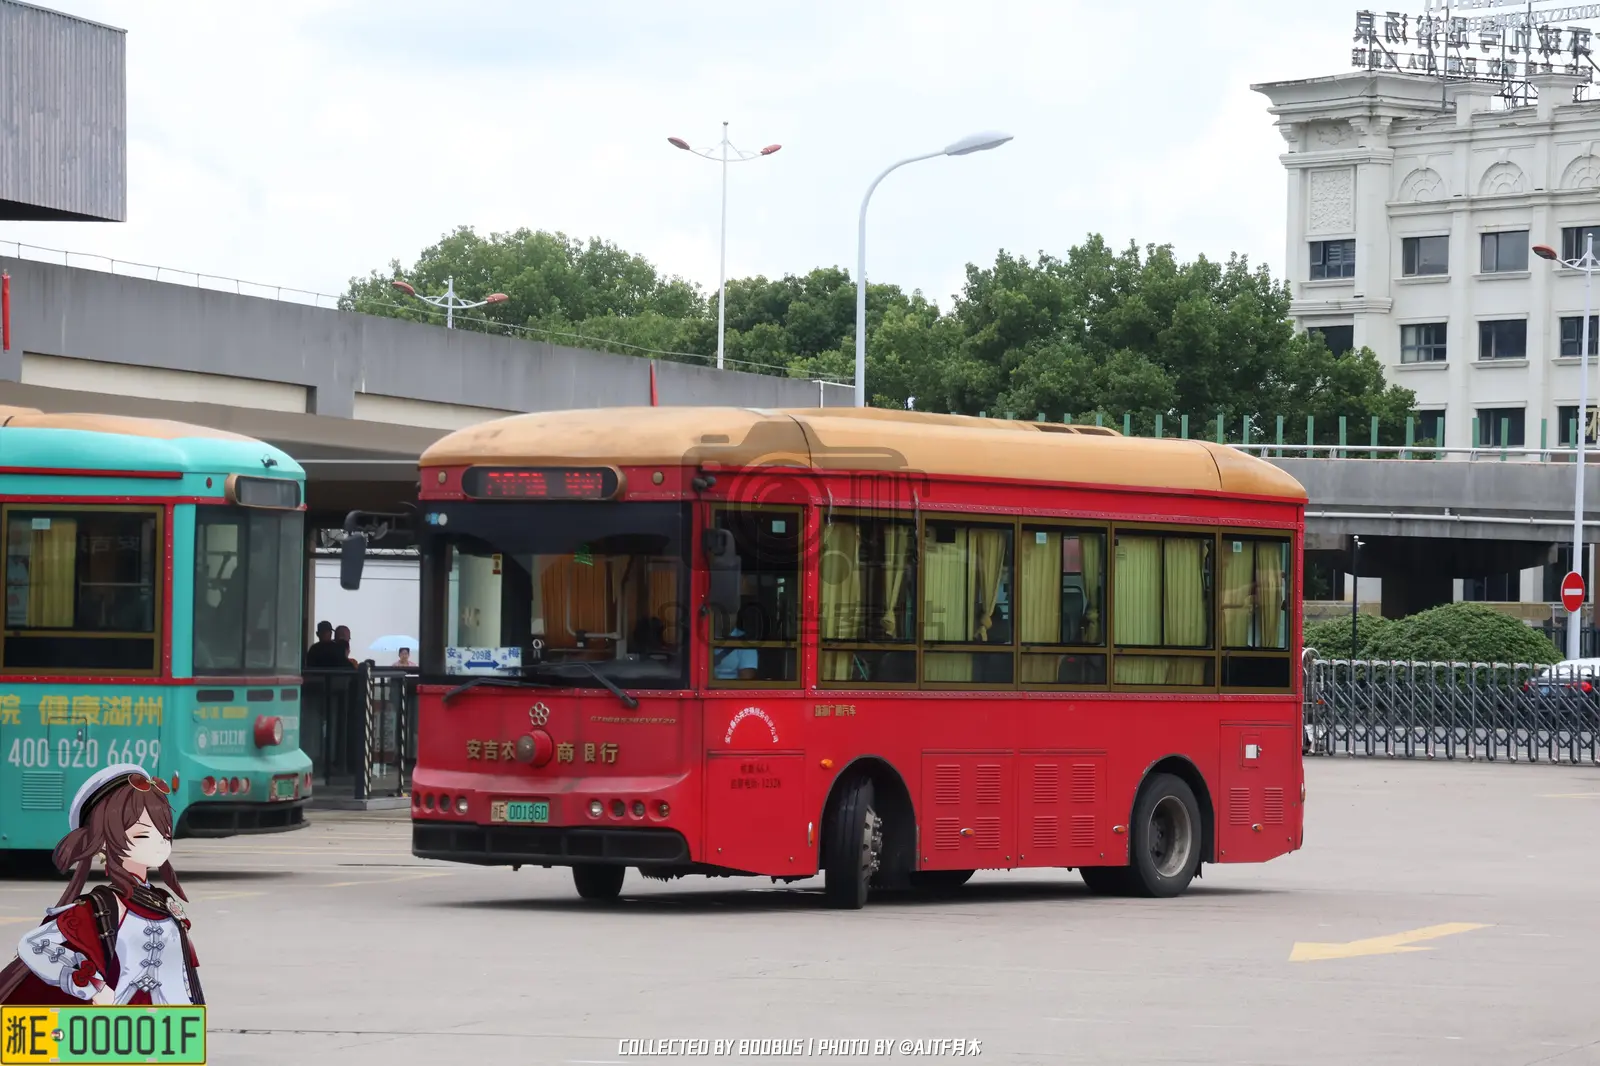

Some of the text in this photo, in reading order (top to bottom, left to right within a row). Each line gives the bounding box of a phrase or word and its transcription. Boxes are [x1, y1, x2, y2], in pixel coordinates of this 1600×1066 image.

[38, 694, 163, 726] 健康湖州
[8, 738, 161, 768] 400 020 6699
